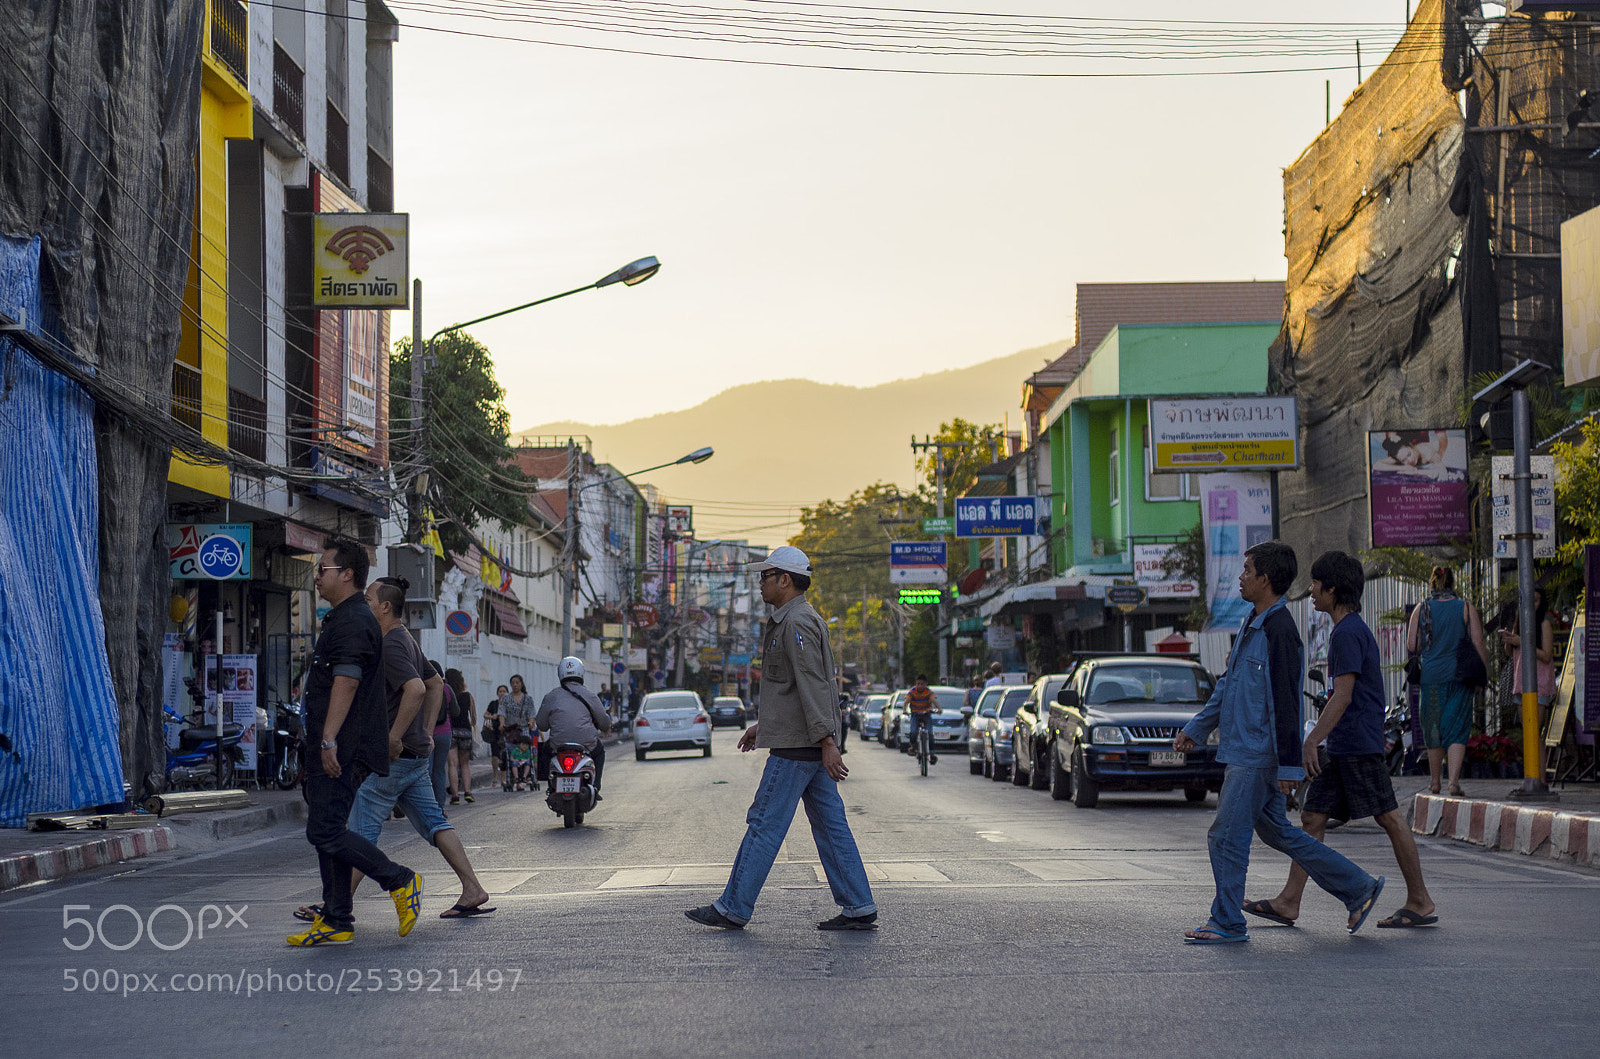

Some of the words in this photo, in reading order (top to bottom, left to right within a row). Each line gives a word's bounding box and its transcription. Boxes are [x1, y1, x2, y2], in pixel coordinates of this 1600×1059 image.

[320, 276, 398, 297] สีตราพัด
[1232, 450, 1285, 462] Charmant
[958, 504, 987, 521] แอล
[990, 500, 1001, 520] พี
[1005, 503, 1034, 520] แอล
